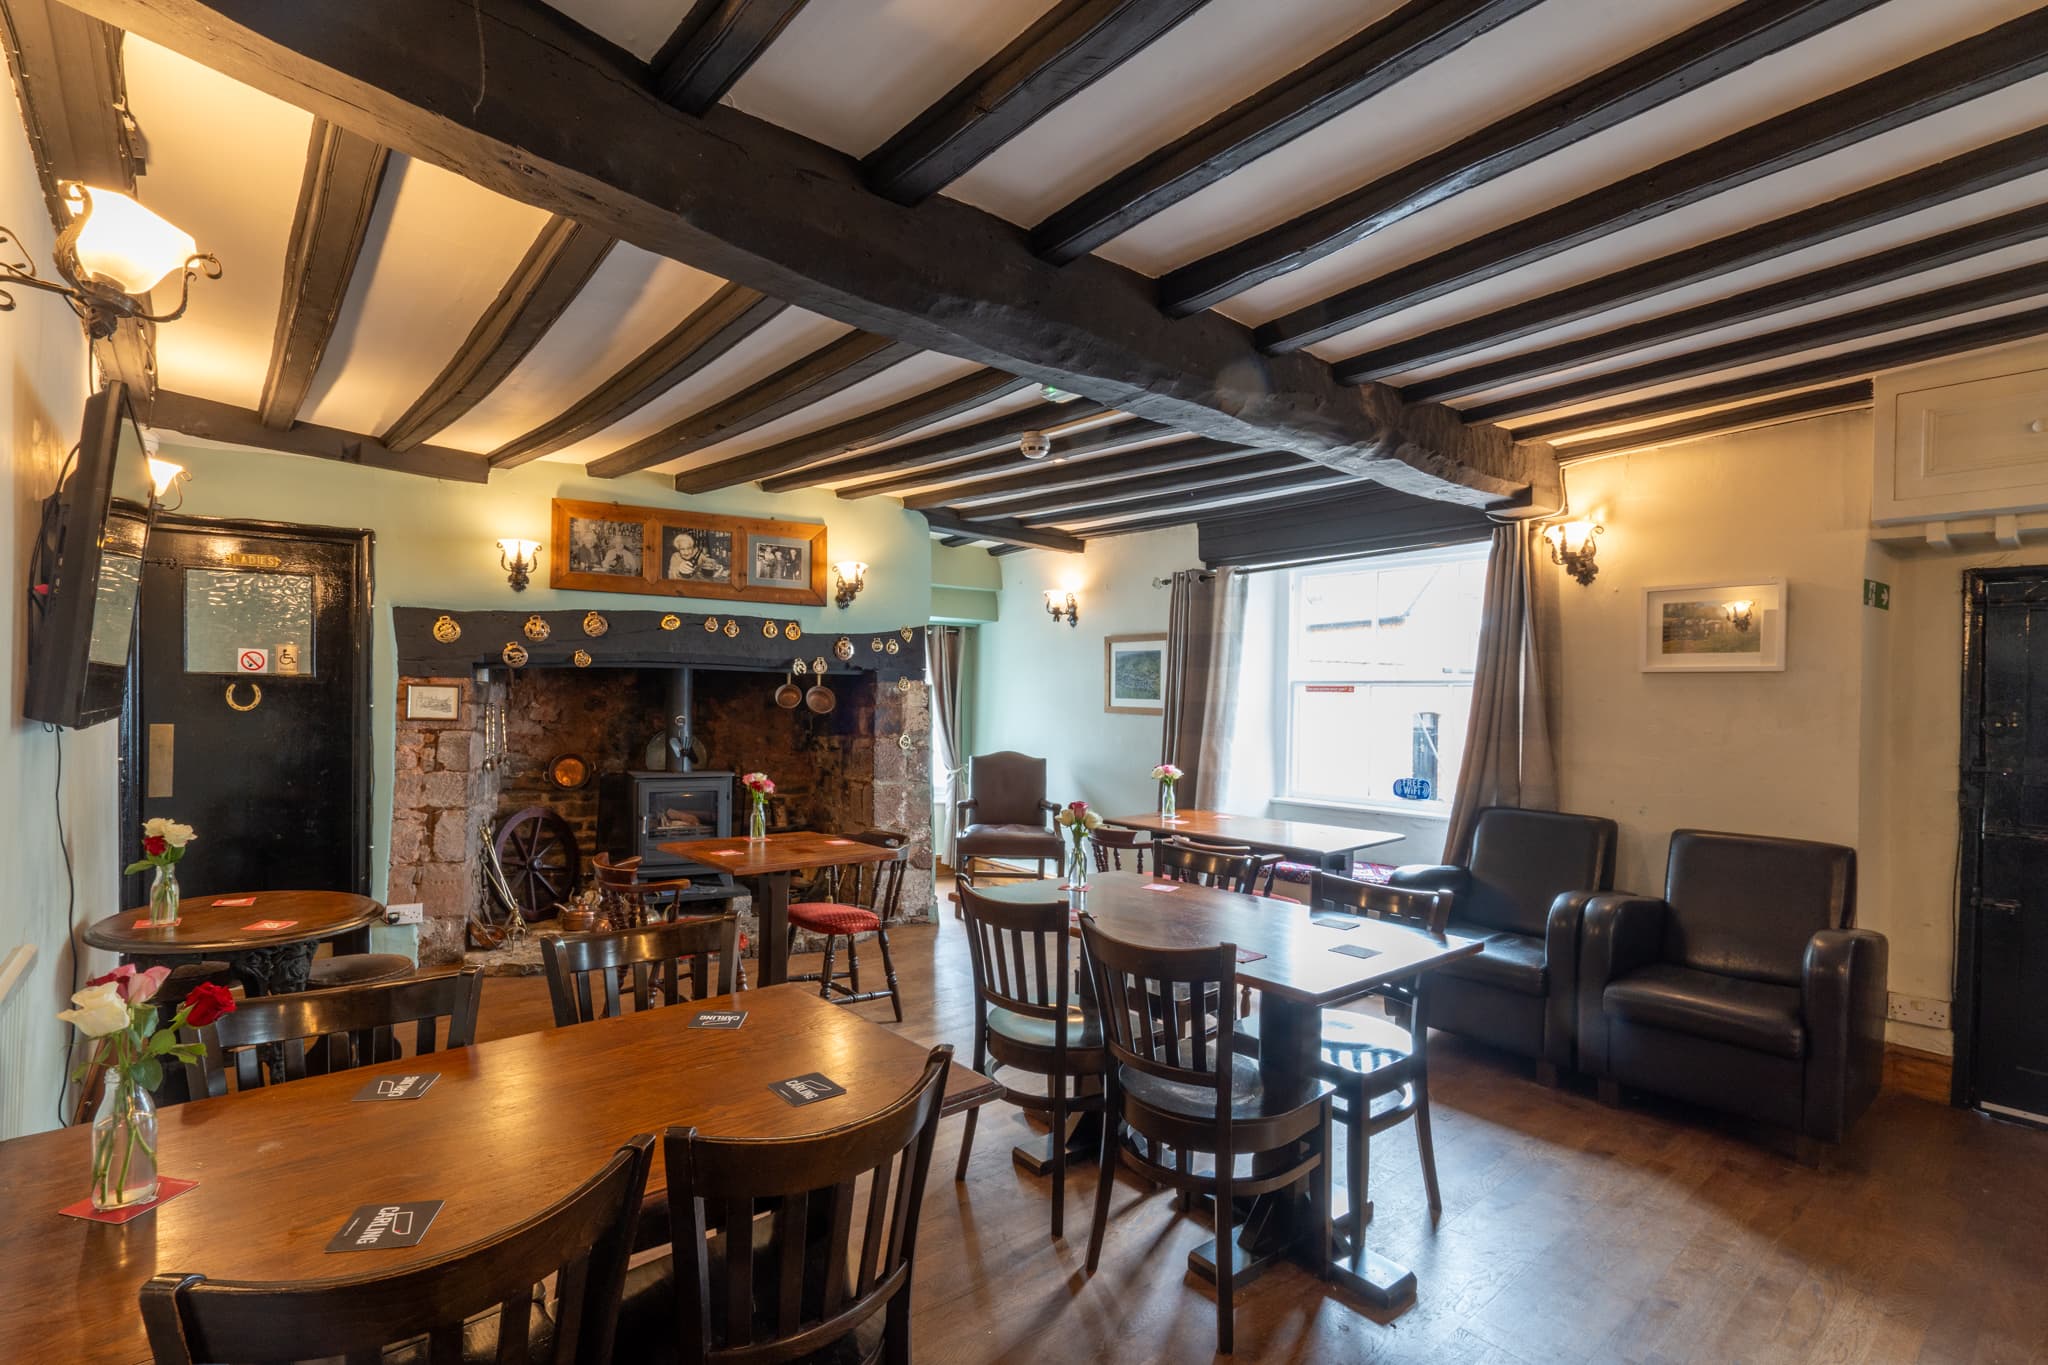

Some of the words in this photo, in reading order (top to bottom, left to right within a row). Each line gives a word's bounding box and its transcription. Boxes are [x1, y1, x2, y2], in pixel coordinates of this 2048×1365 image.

[232, 555, 275, 565] LADIES
[1403, 778, 1424, 787] FREE
[785, 1080, 819, 1100] CARLING
[356, 1206, 400, 1244] CARLING
